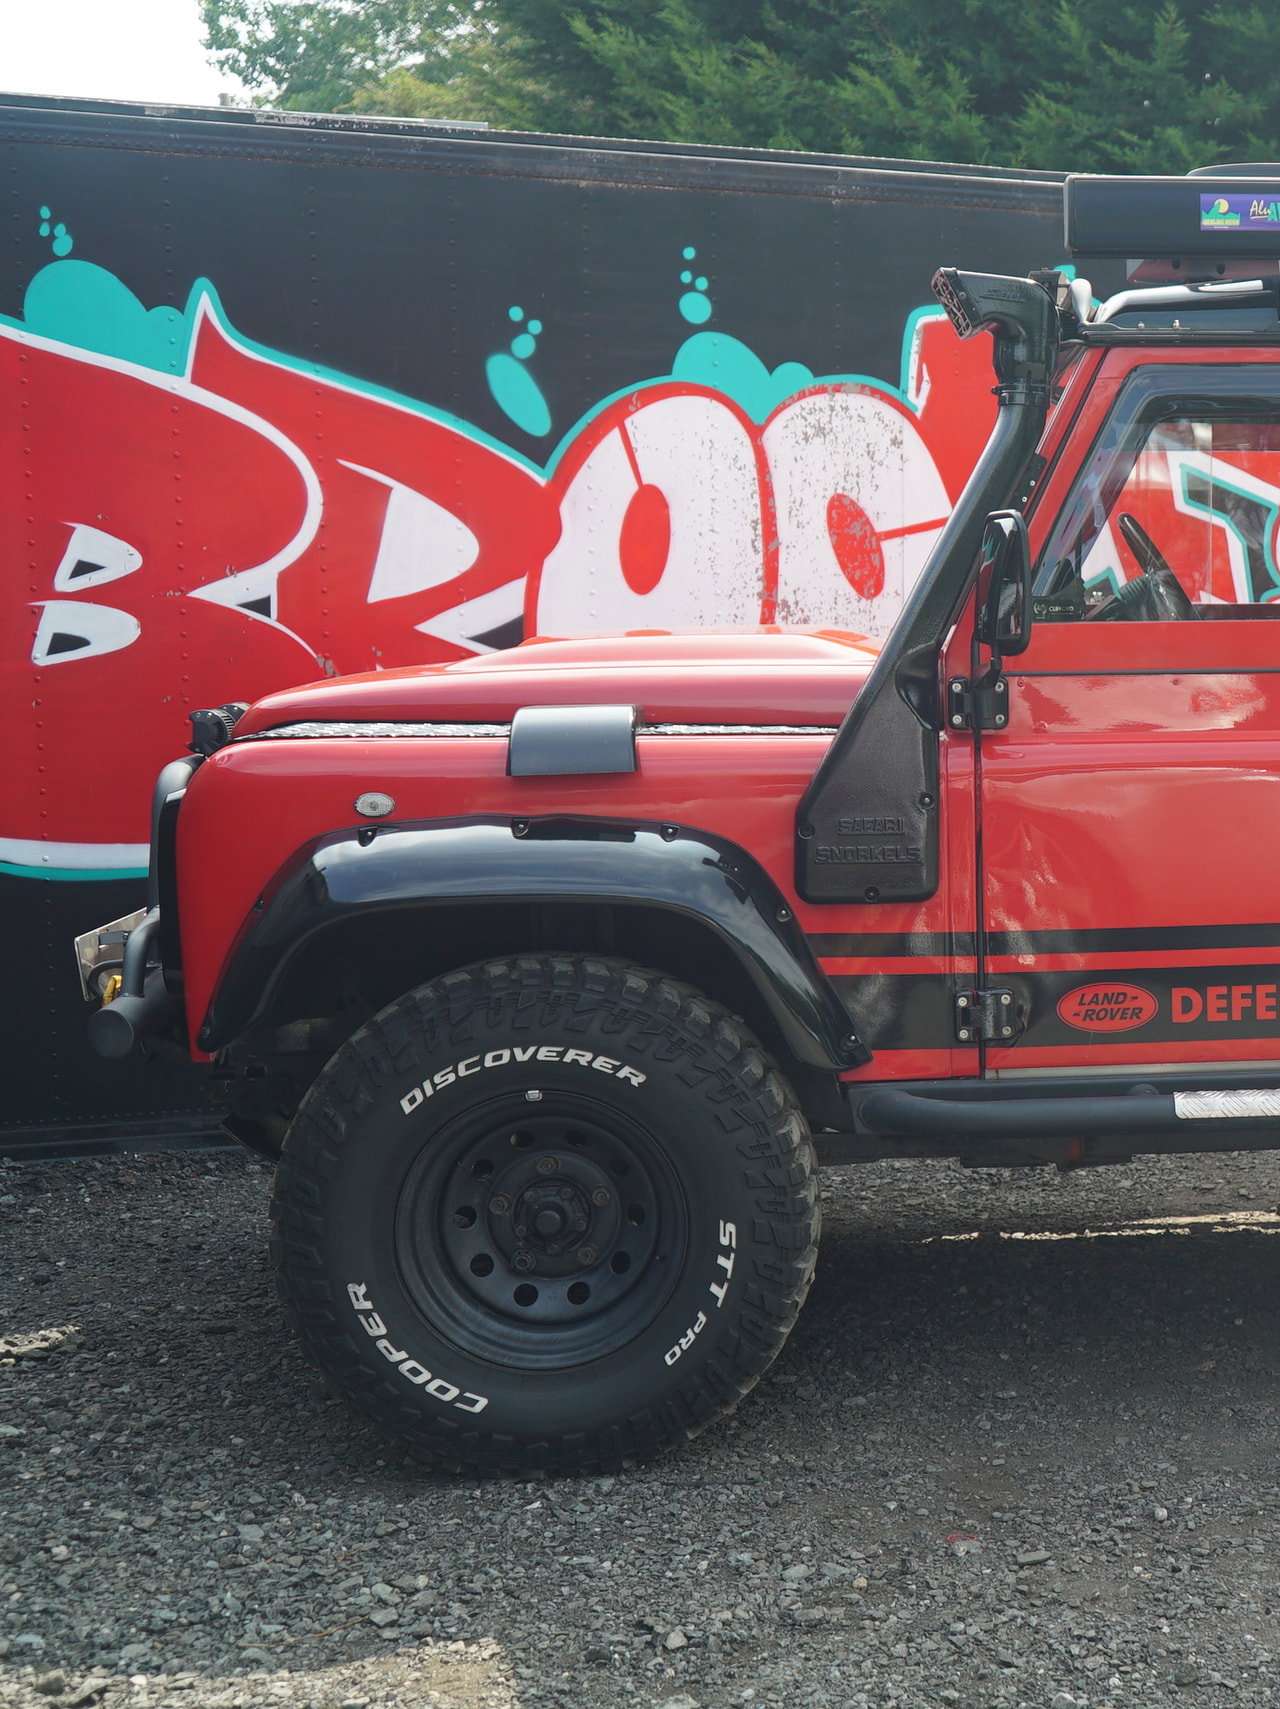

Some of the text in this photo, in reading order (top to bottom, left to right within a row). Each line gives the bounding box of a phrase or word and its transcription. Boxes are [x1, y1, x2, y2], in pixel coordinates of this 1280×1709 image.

[815, 846, 922, 864] SNORKELS
[838, 816, 905, 834] SAFARI
[400, 1045, 647, 1115] DISCOVERER
[664, 1219, 736, 1367] STT PRO
[346, 1281, 488, 1414] COOPER
